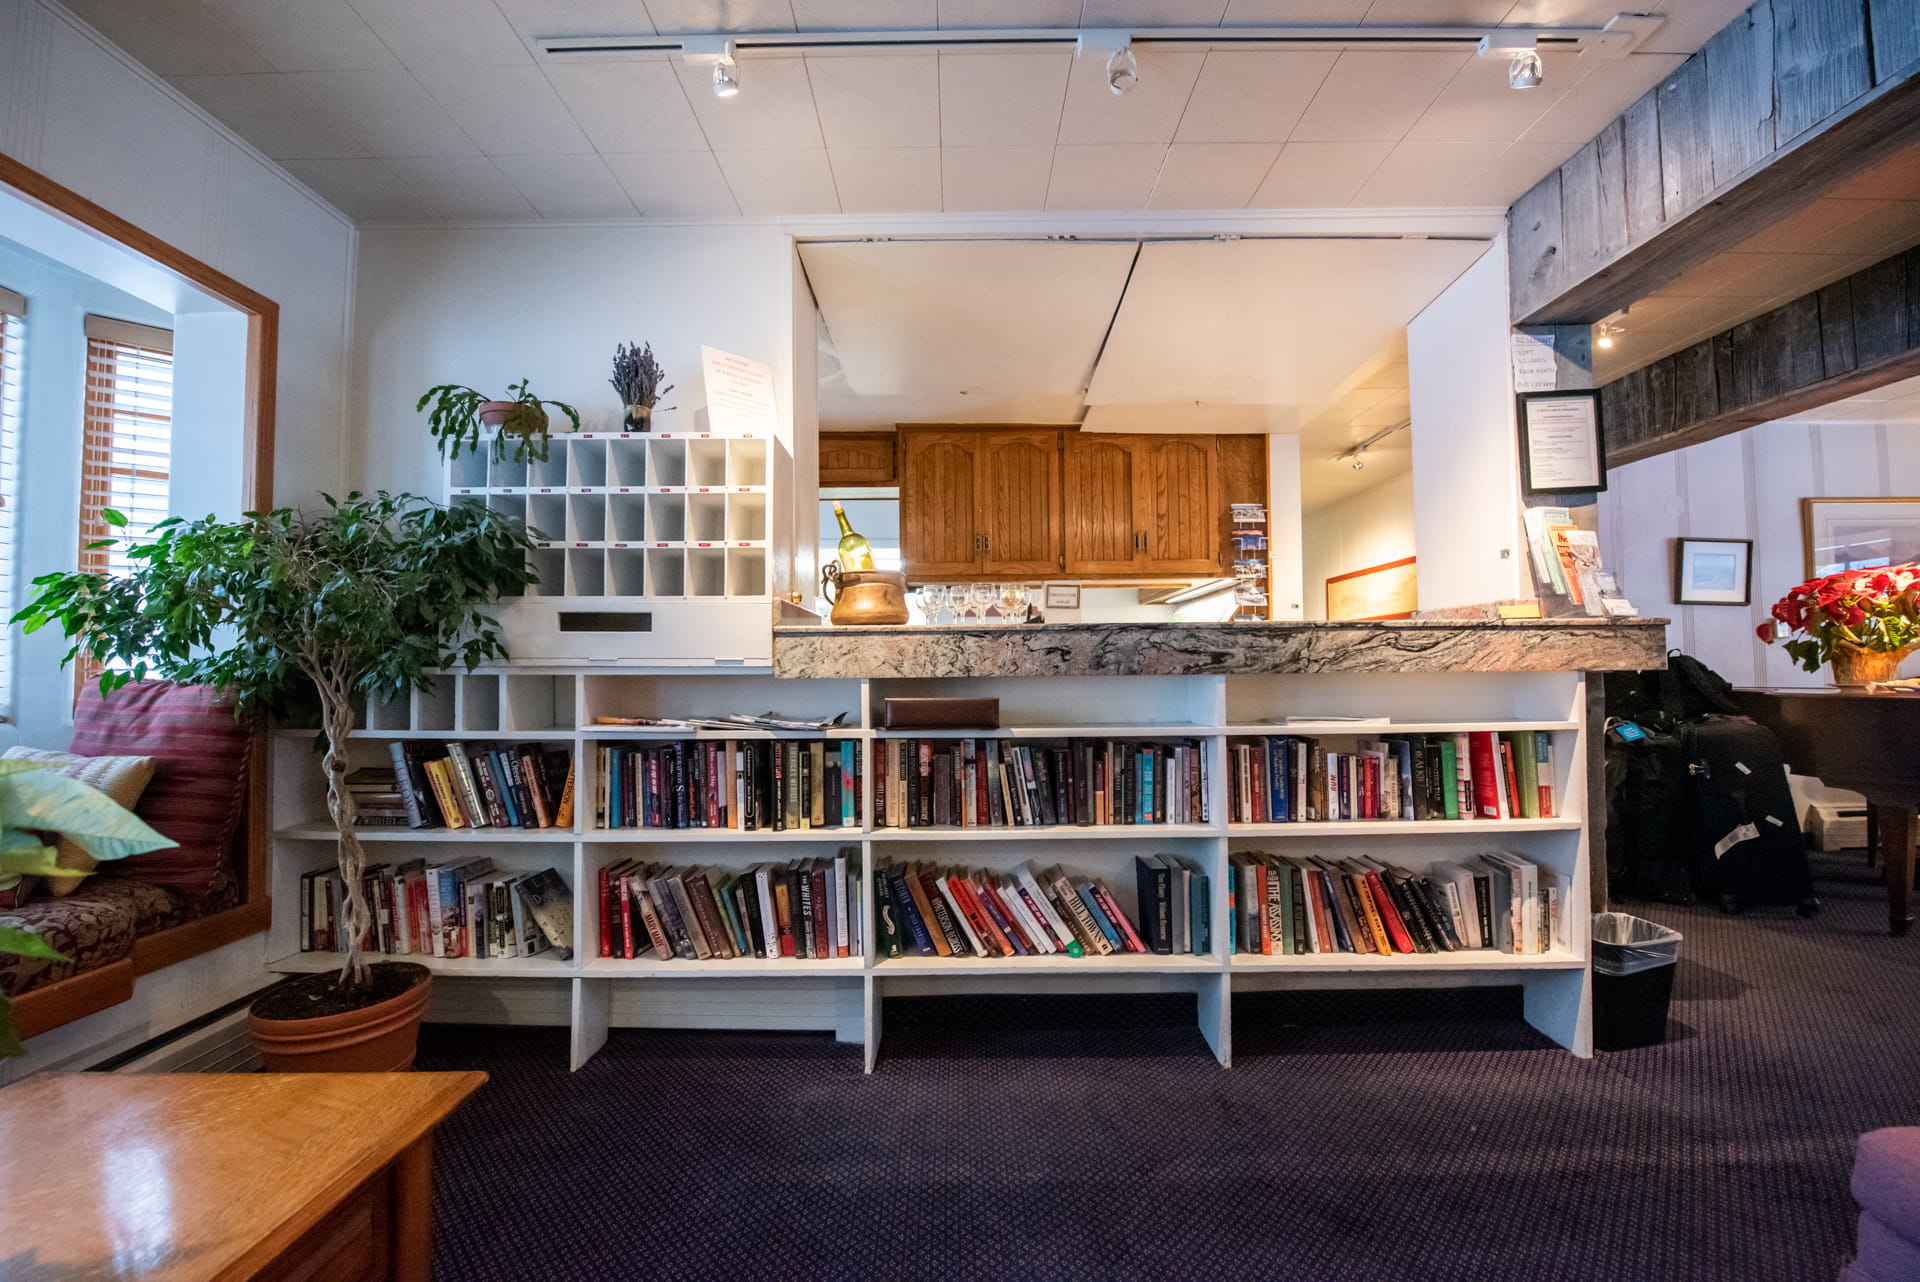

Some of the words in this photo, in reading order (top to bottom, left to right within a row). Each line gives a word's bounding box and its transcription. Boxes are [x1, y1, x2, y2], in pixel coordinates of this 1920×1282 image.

[509, 760, 523, 786] Cleeves
[802, 884, 812, 916] WHITES
[932, 899, 953, 933] PATTERSON
[1068, 897, 1087, 918] HILL
[643, 913, 657, 931] MARY
[650, 929, 664, 948] MARY
[1269, 901, 1282, 941] ASSASSINS
